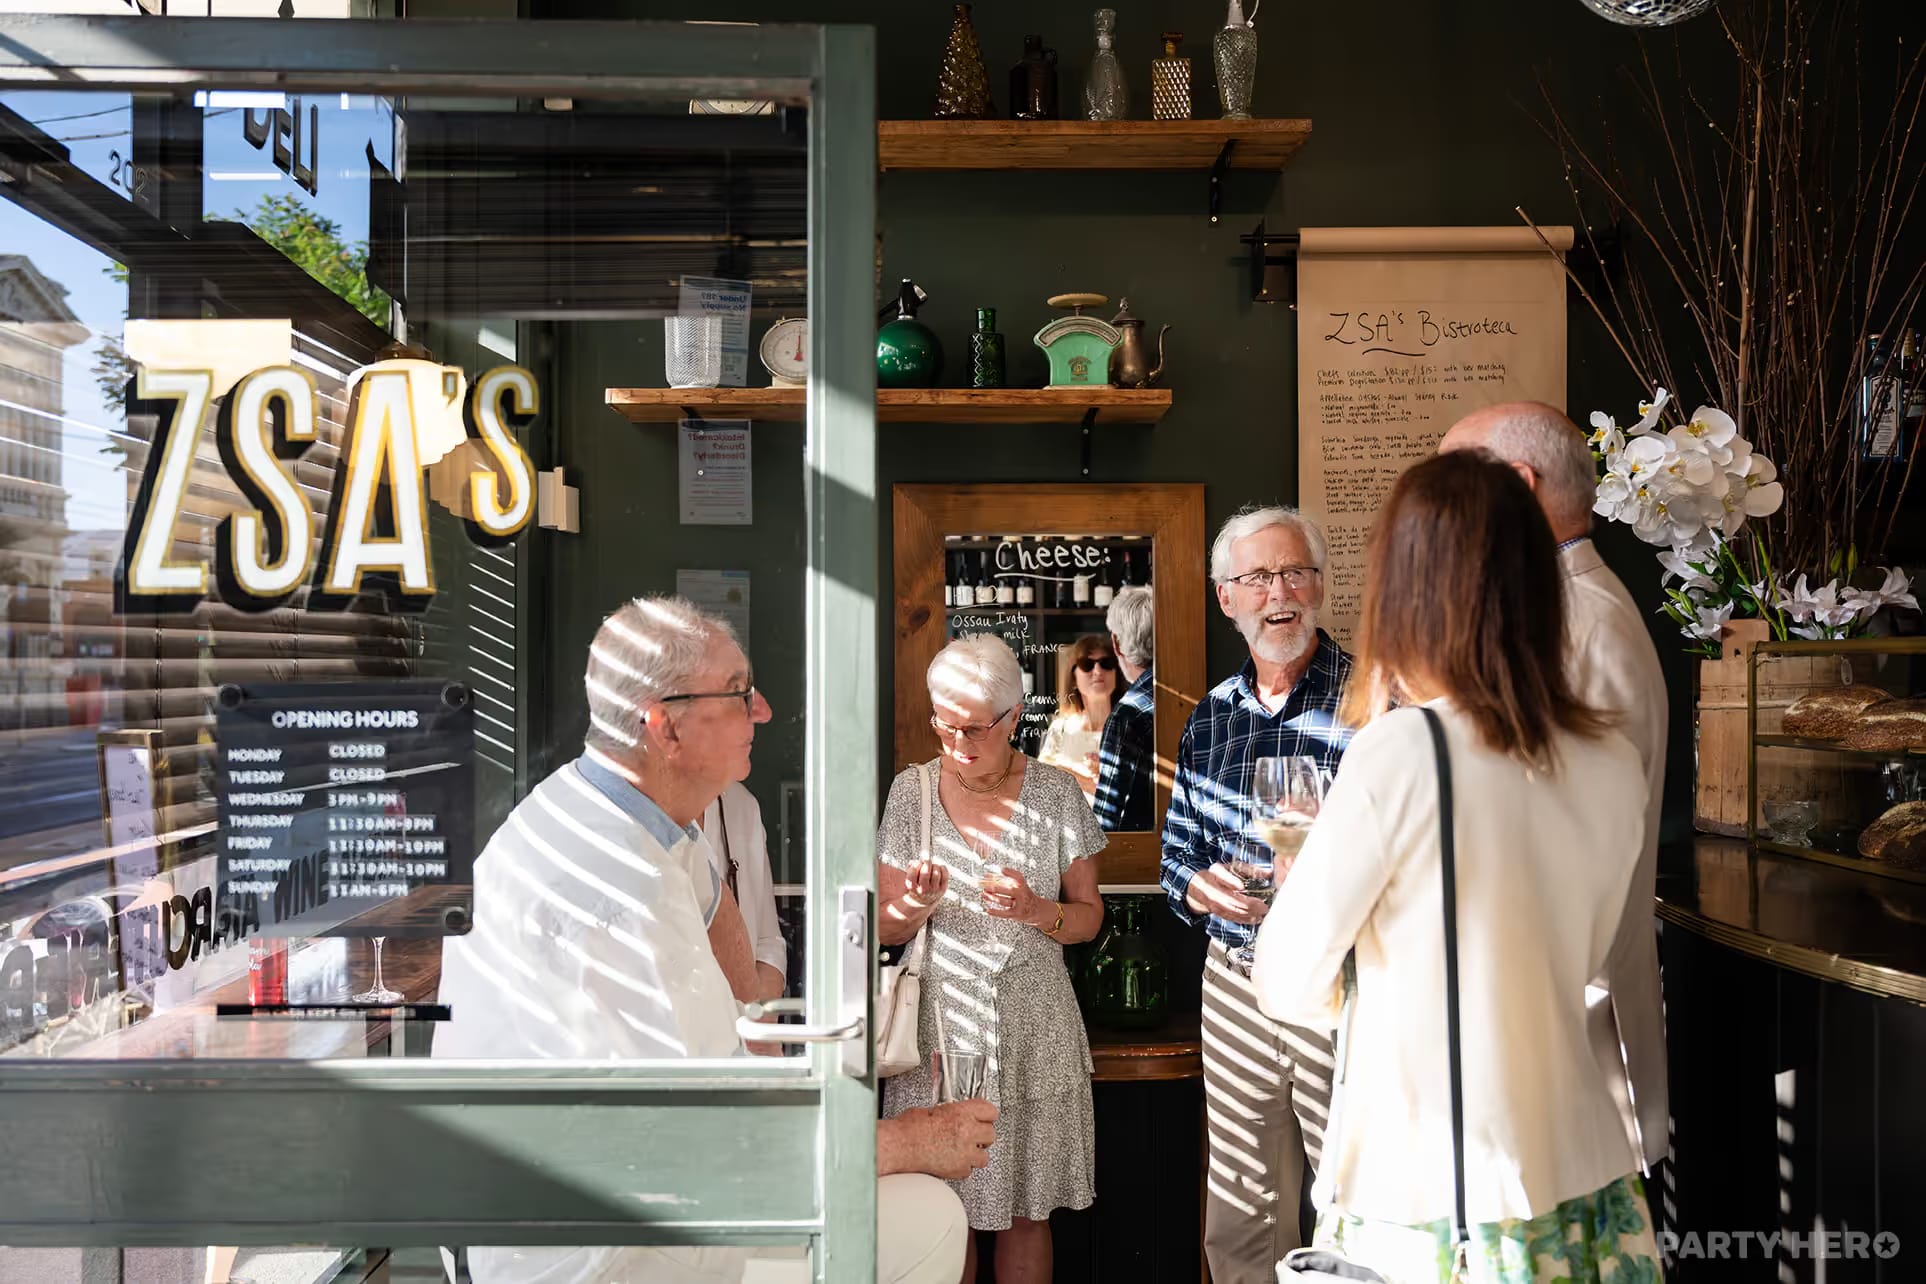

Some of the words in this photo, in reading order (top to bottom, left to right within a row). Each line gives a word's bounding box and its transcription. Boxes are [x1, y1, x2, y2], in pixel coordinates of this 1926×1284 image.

[1418, 310, 1517, 346] Bistroteca
[995, 541, 1111, 571] Cheese:
[952, 613, 992, 628] Ossau
[1003, 630, 1030, 640] milk
[272, 711, 354, 728] OPENING
[355, 710, 419, 728] HOURS
[228, 749, 282, 762] MONDAY
[329, 744, 386, 758] CLOSED
[229, 771, 285, 784] TUESDAY
[329, 768, 386, 781] CLOSED
[228, 793, 305, 806] WEDNESDAY
[229, 815, 293, 828] THURSDAY
[228, 836, 273, 850] FRIDAY
[228, 859, 292, 872] SATURDAY
[228, 881, 279, 894] SUNDAY
